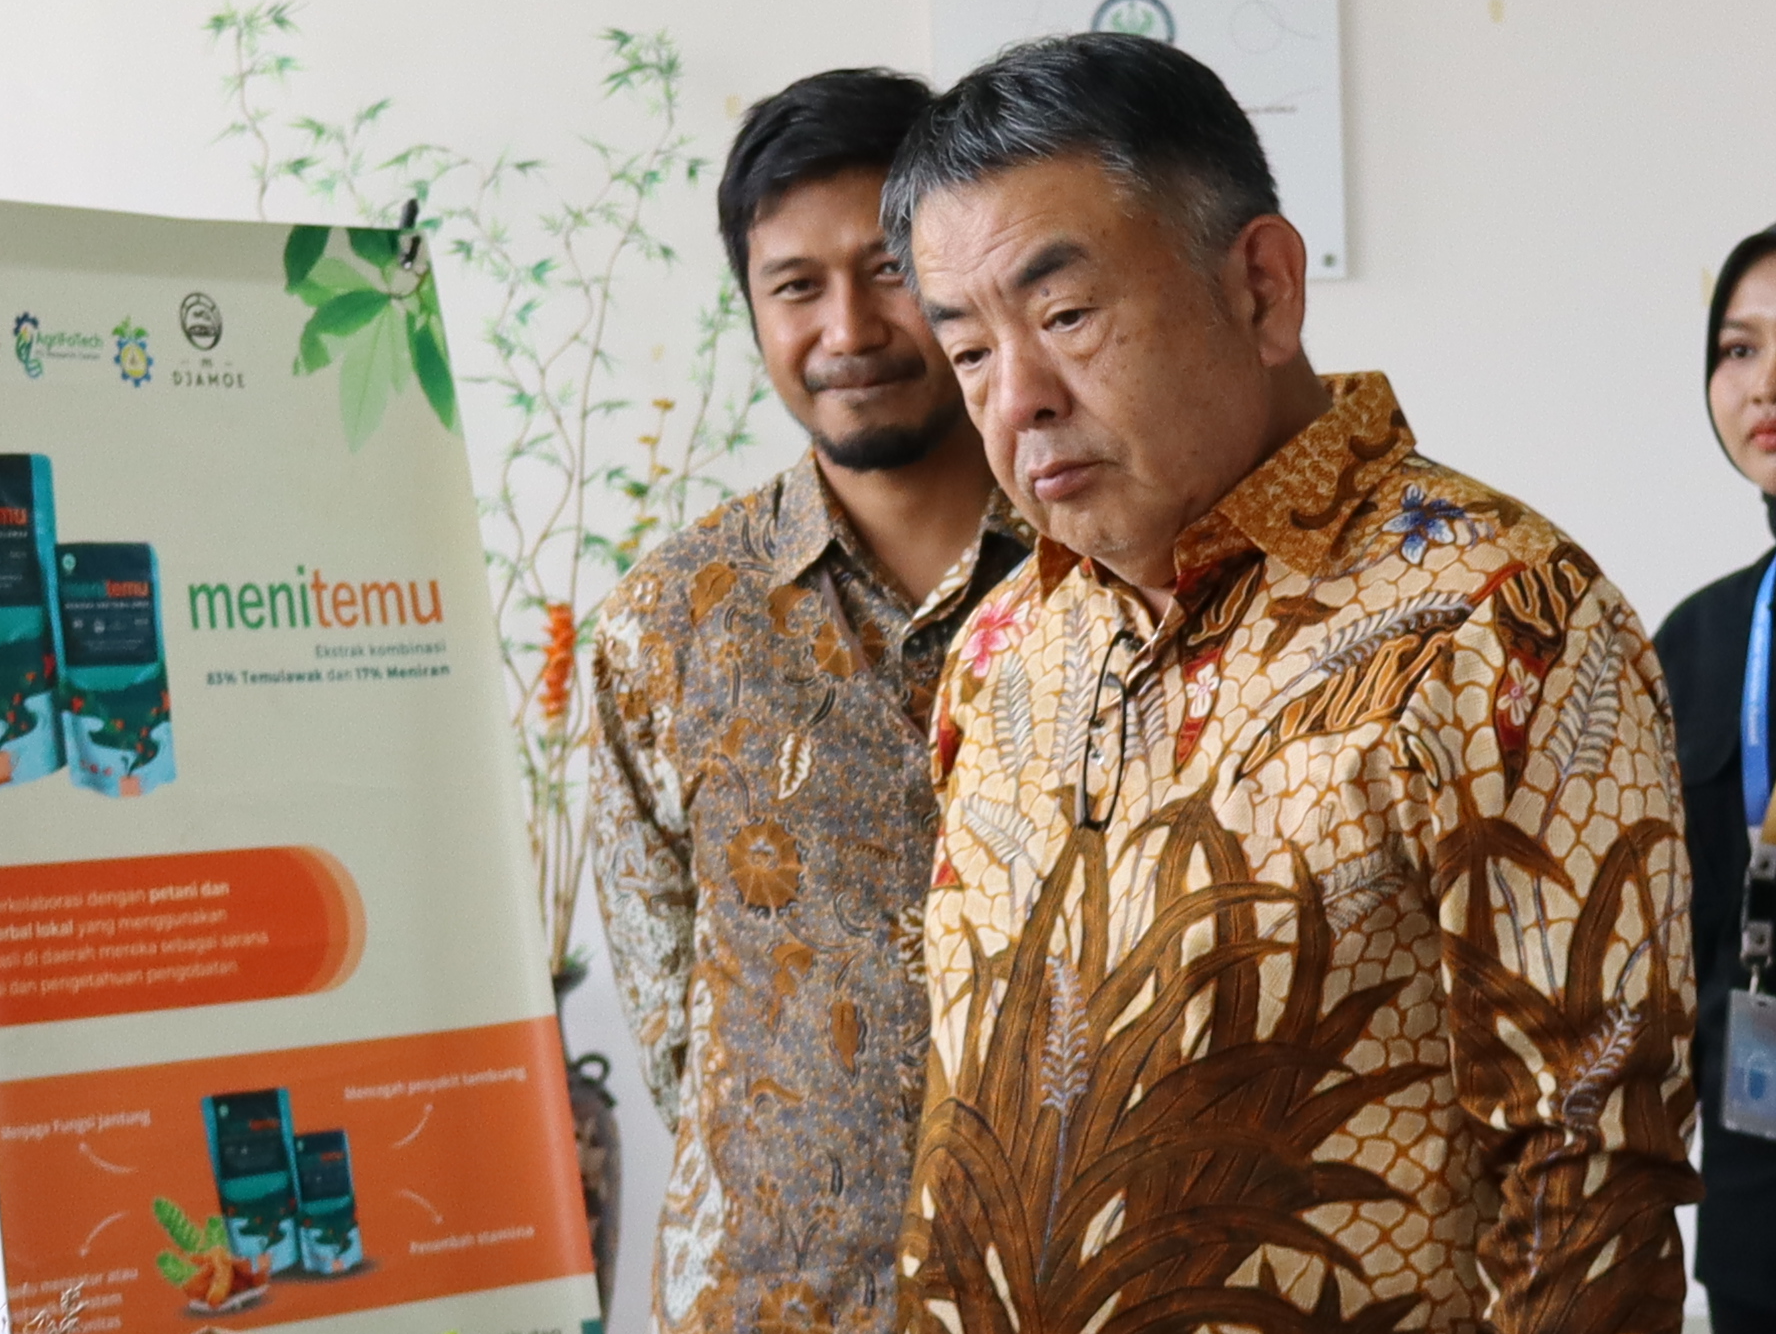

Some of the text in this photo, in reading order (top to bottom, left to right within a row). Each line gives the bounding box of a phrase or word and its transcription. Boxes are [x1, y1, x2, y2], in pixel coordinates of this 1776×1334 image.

[188, 564, 444, 630] menitemu
[314, 639, 447, 659] Ekstrak kombinasi
[240, 669, 323, 685] Temulawak
[327, 668, 352, 682] dan
[387, 663, 451, 680] Meniran
[87, 890, 146, 908] dengan
[149, 881, 199, 904] petani
[200, 881, 230, 897] dan
[35, 918, 74, 938] lokal
[78, 918, 115, 940] yang
